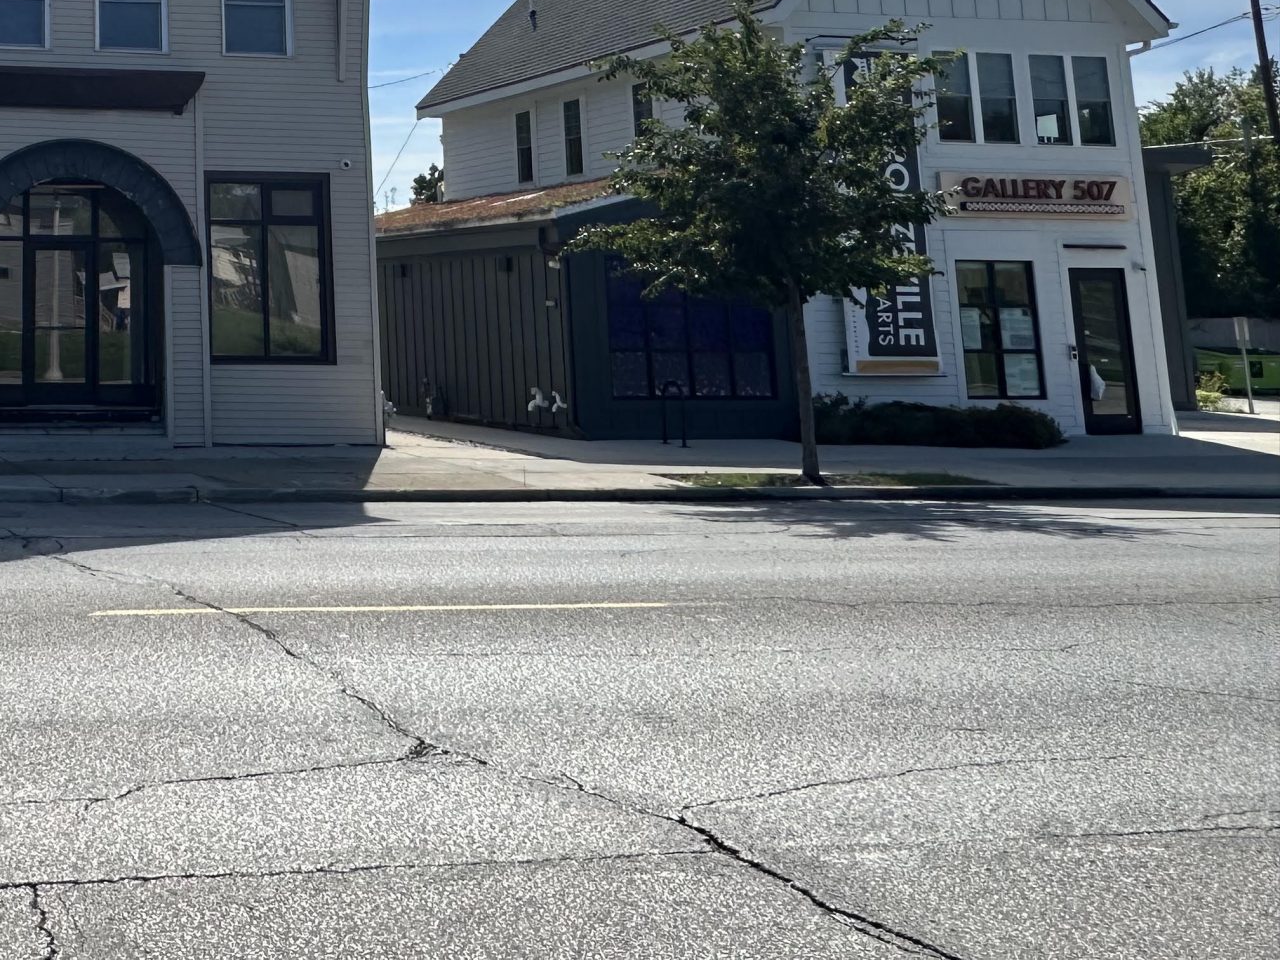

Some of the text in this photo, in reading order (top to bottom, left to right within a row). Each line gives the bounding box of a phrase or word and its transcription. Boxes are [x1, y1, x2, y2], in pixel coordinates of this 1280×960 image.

[961, 177, 1117, 201] GALLERY 507
[876, 296, 894, 346] ARTS
